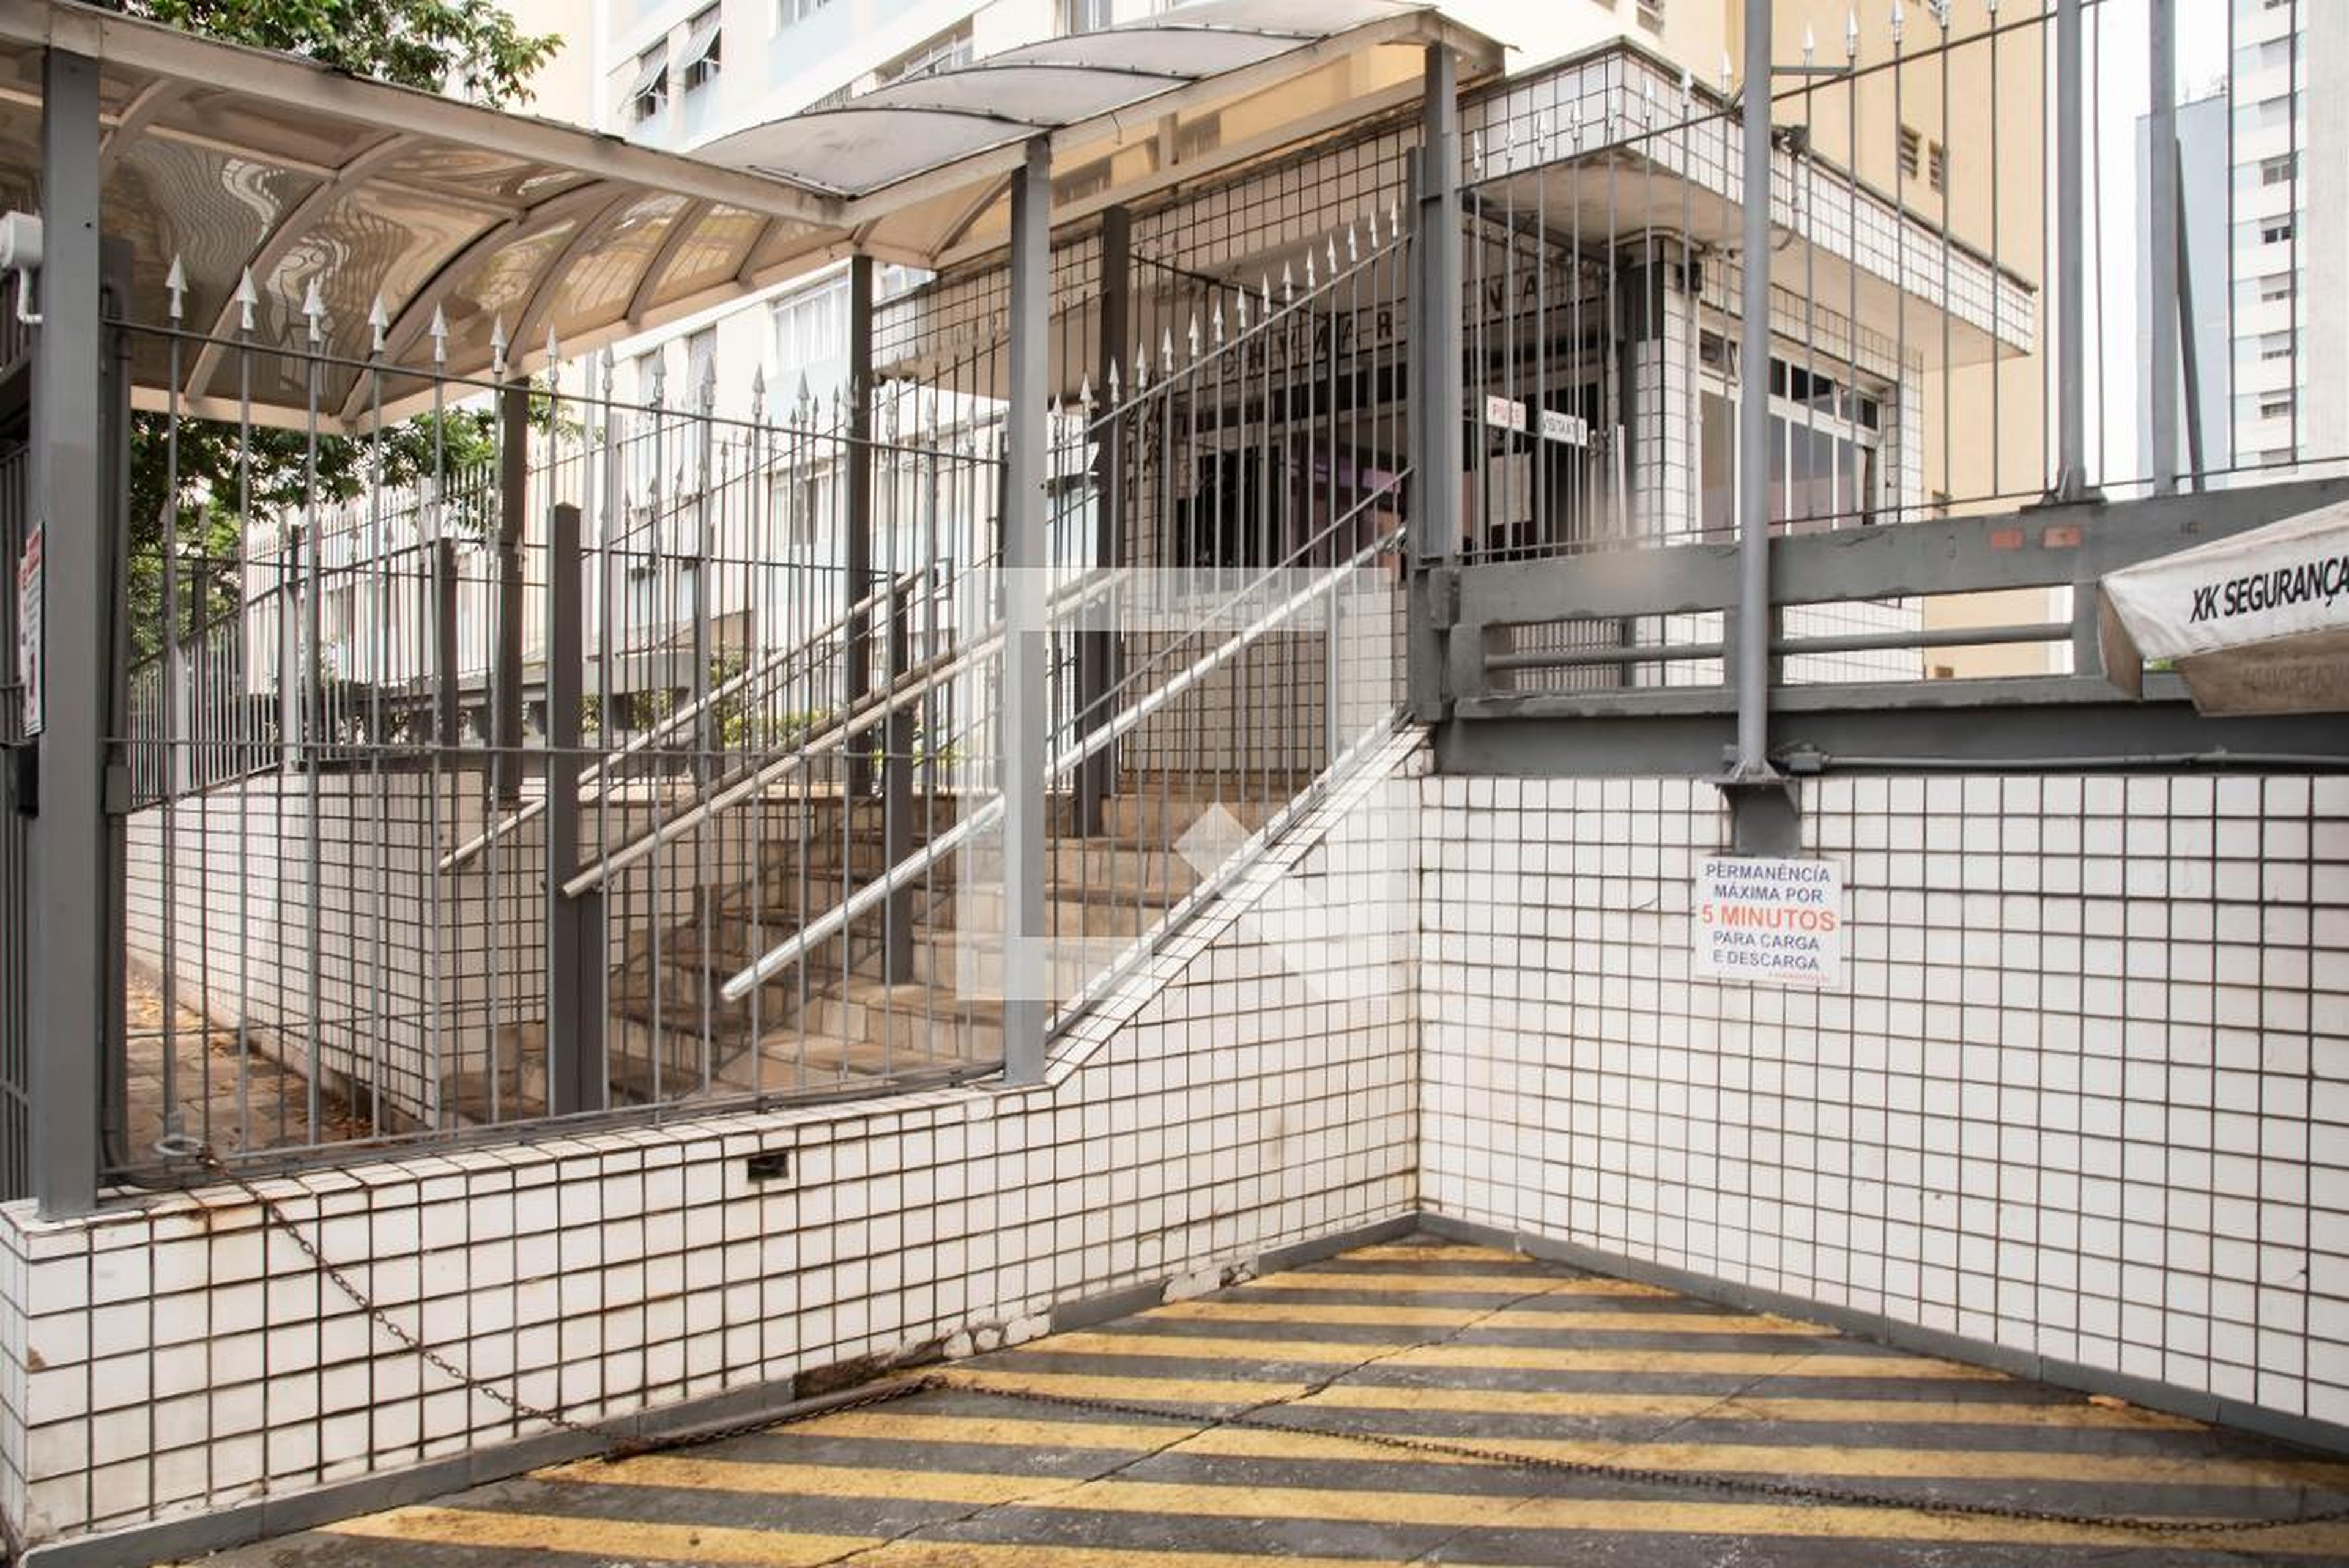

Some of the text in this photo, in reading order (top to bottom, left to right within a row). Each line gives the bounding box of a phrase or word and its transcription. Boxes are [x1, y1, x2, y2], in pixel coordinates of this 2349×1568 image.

[2190, 585, 2220, 624] XK
[1715, 882, 1823, 903] MÁXIMA POR
[1702, 905, 1835, 931] 5 MINUTOS
[1713, 931, 1820, 951] PARA CARGA
[1713, 951, 1819, 971] E DESCARGA
